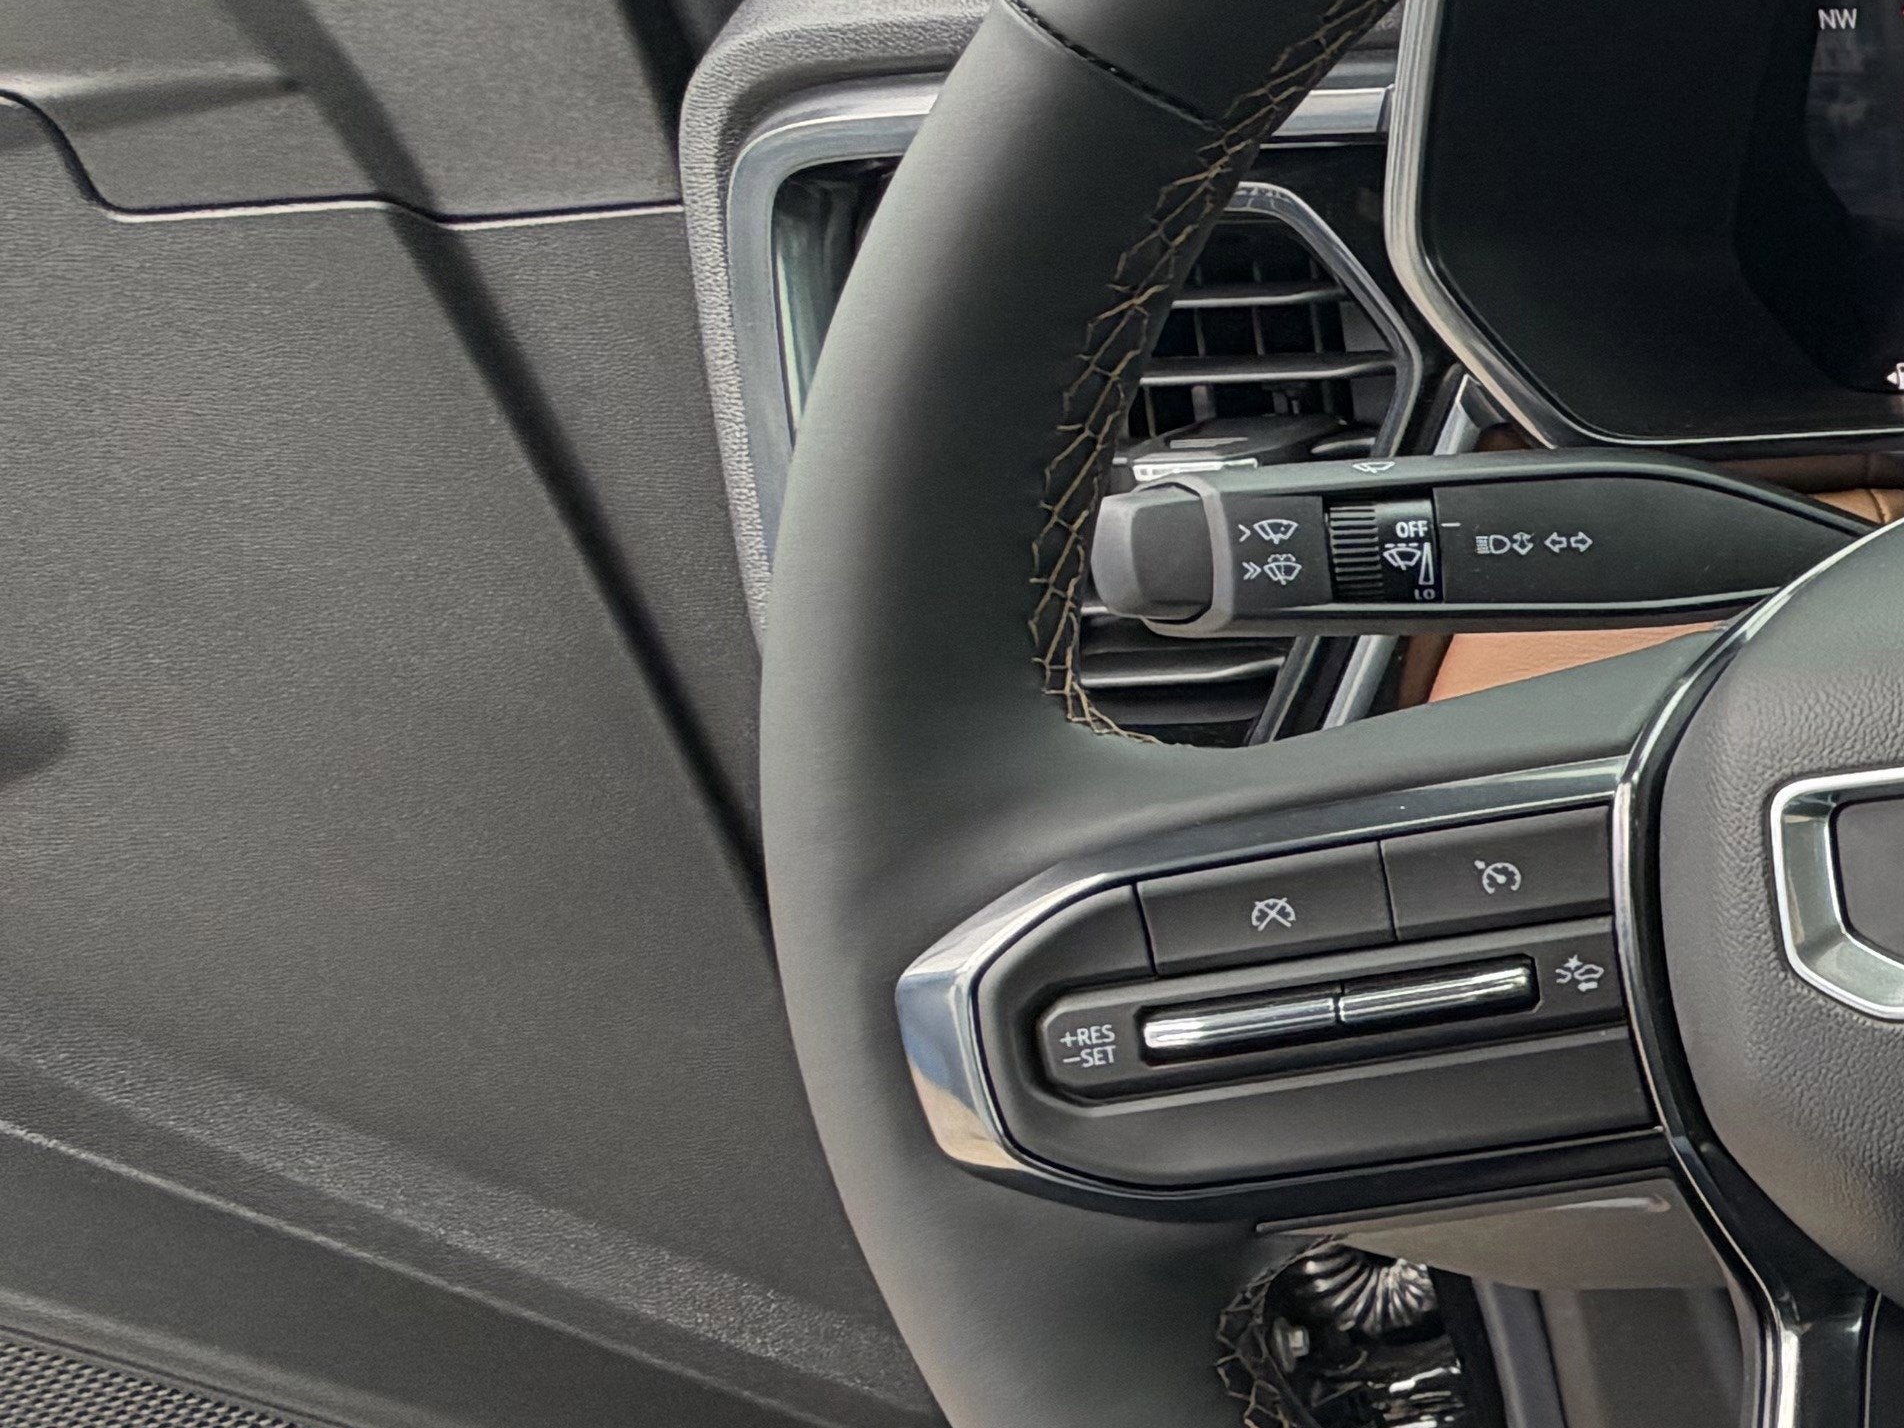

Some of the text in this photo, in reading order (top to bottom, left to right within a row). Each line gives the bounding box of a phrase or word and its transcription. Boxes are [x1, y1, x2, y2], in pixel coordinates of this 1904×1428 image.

[1818, 9, 1858, 29] NW
[1396, 518, 1429, 541] OFF
[1414, 587, 1436, 602] LO
